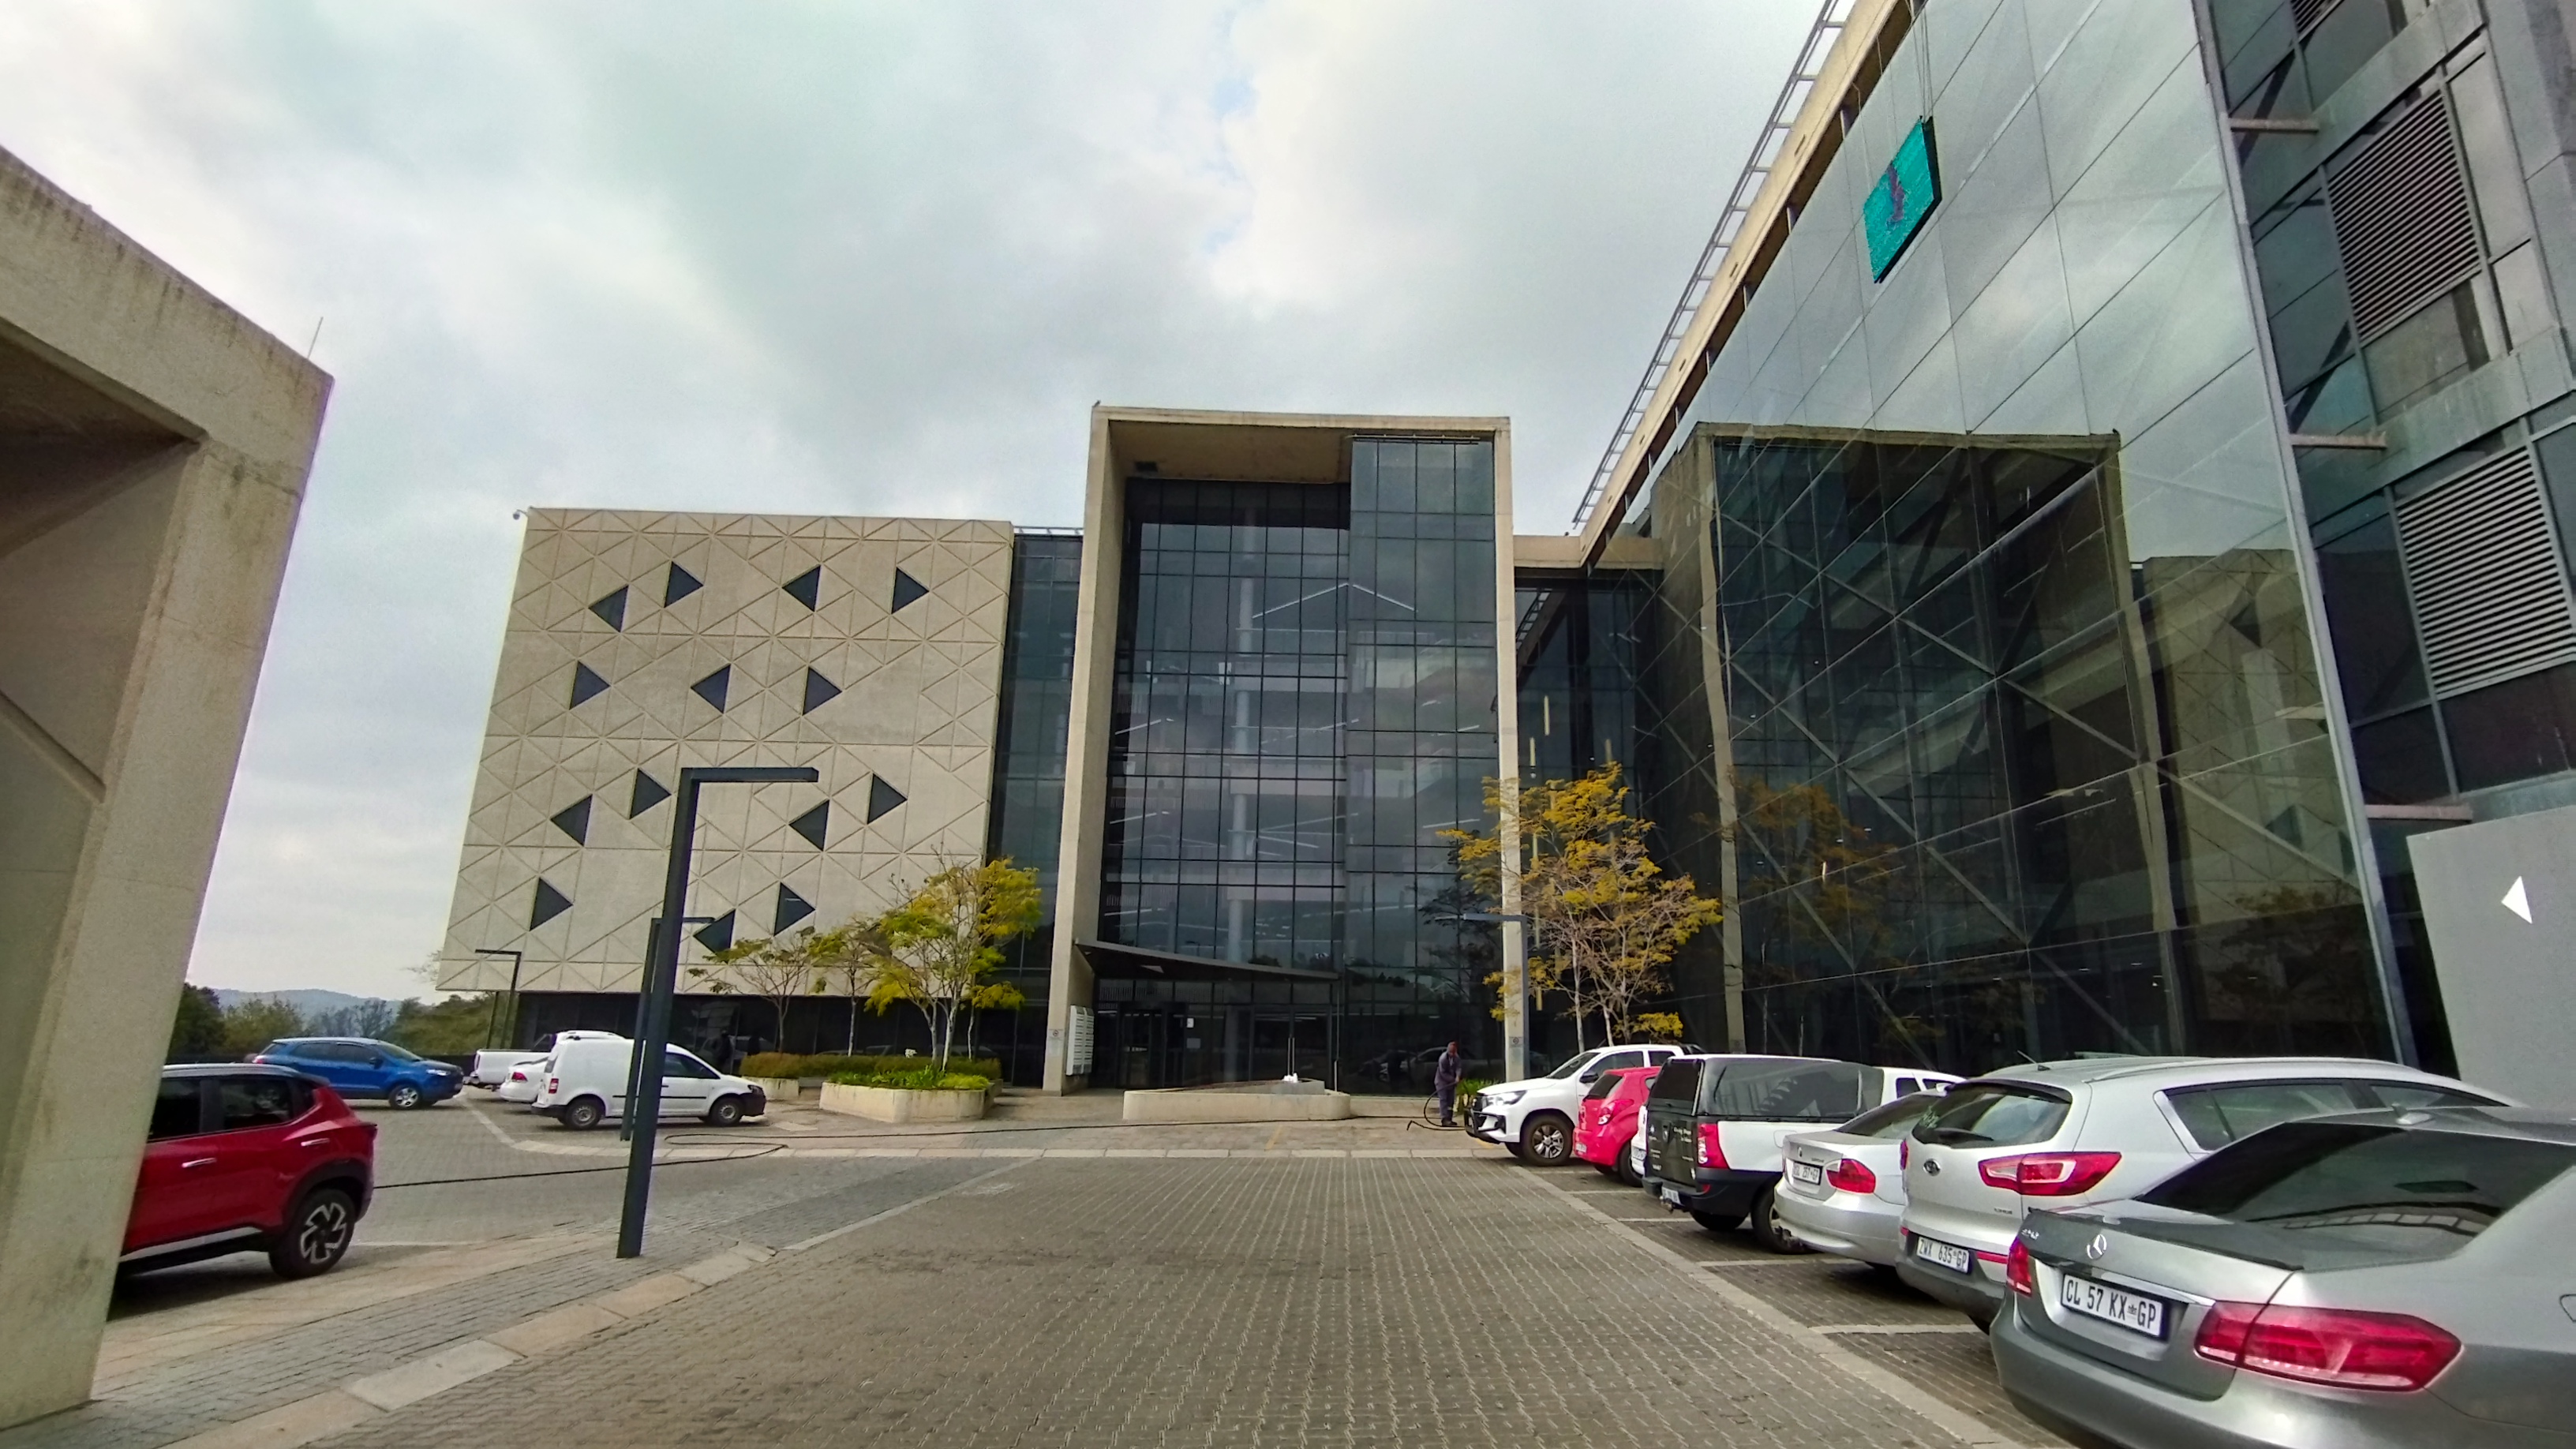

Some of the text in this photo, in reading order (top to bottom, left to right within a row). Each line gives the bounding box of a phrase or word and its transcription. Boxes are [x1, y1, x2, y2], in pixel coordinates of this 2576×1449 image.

[1938, 1245, 1953, 1264] 635
[1956, 1250, 1968, 1268] GP
[2065, 1279, 2156, 1330] CL 57 KX GP
